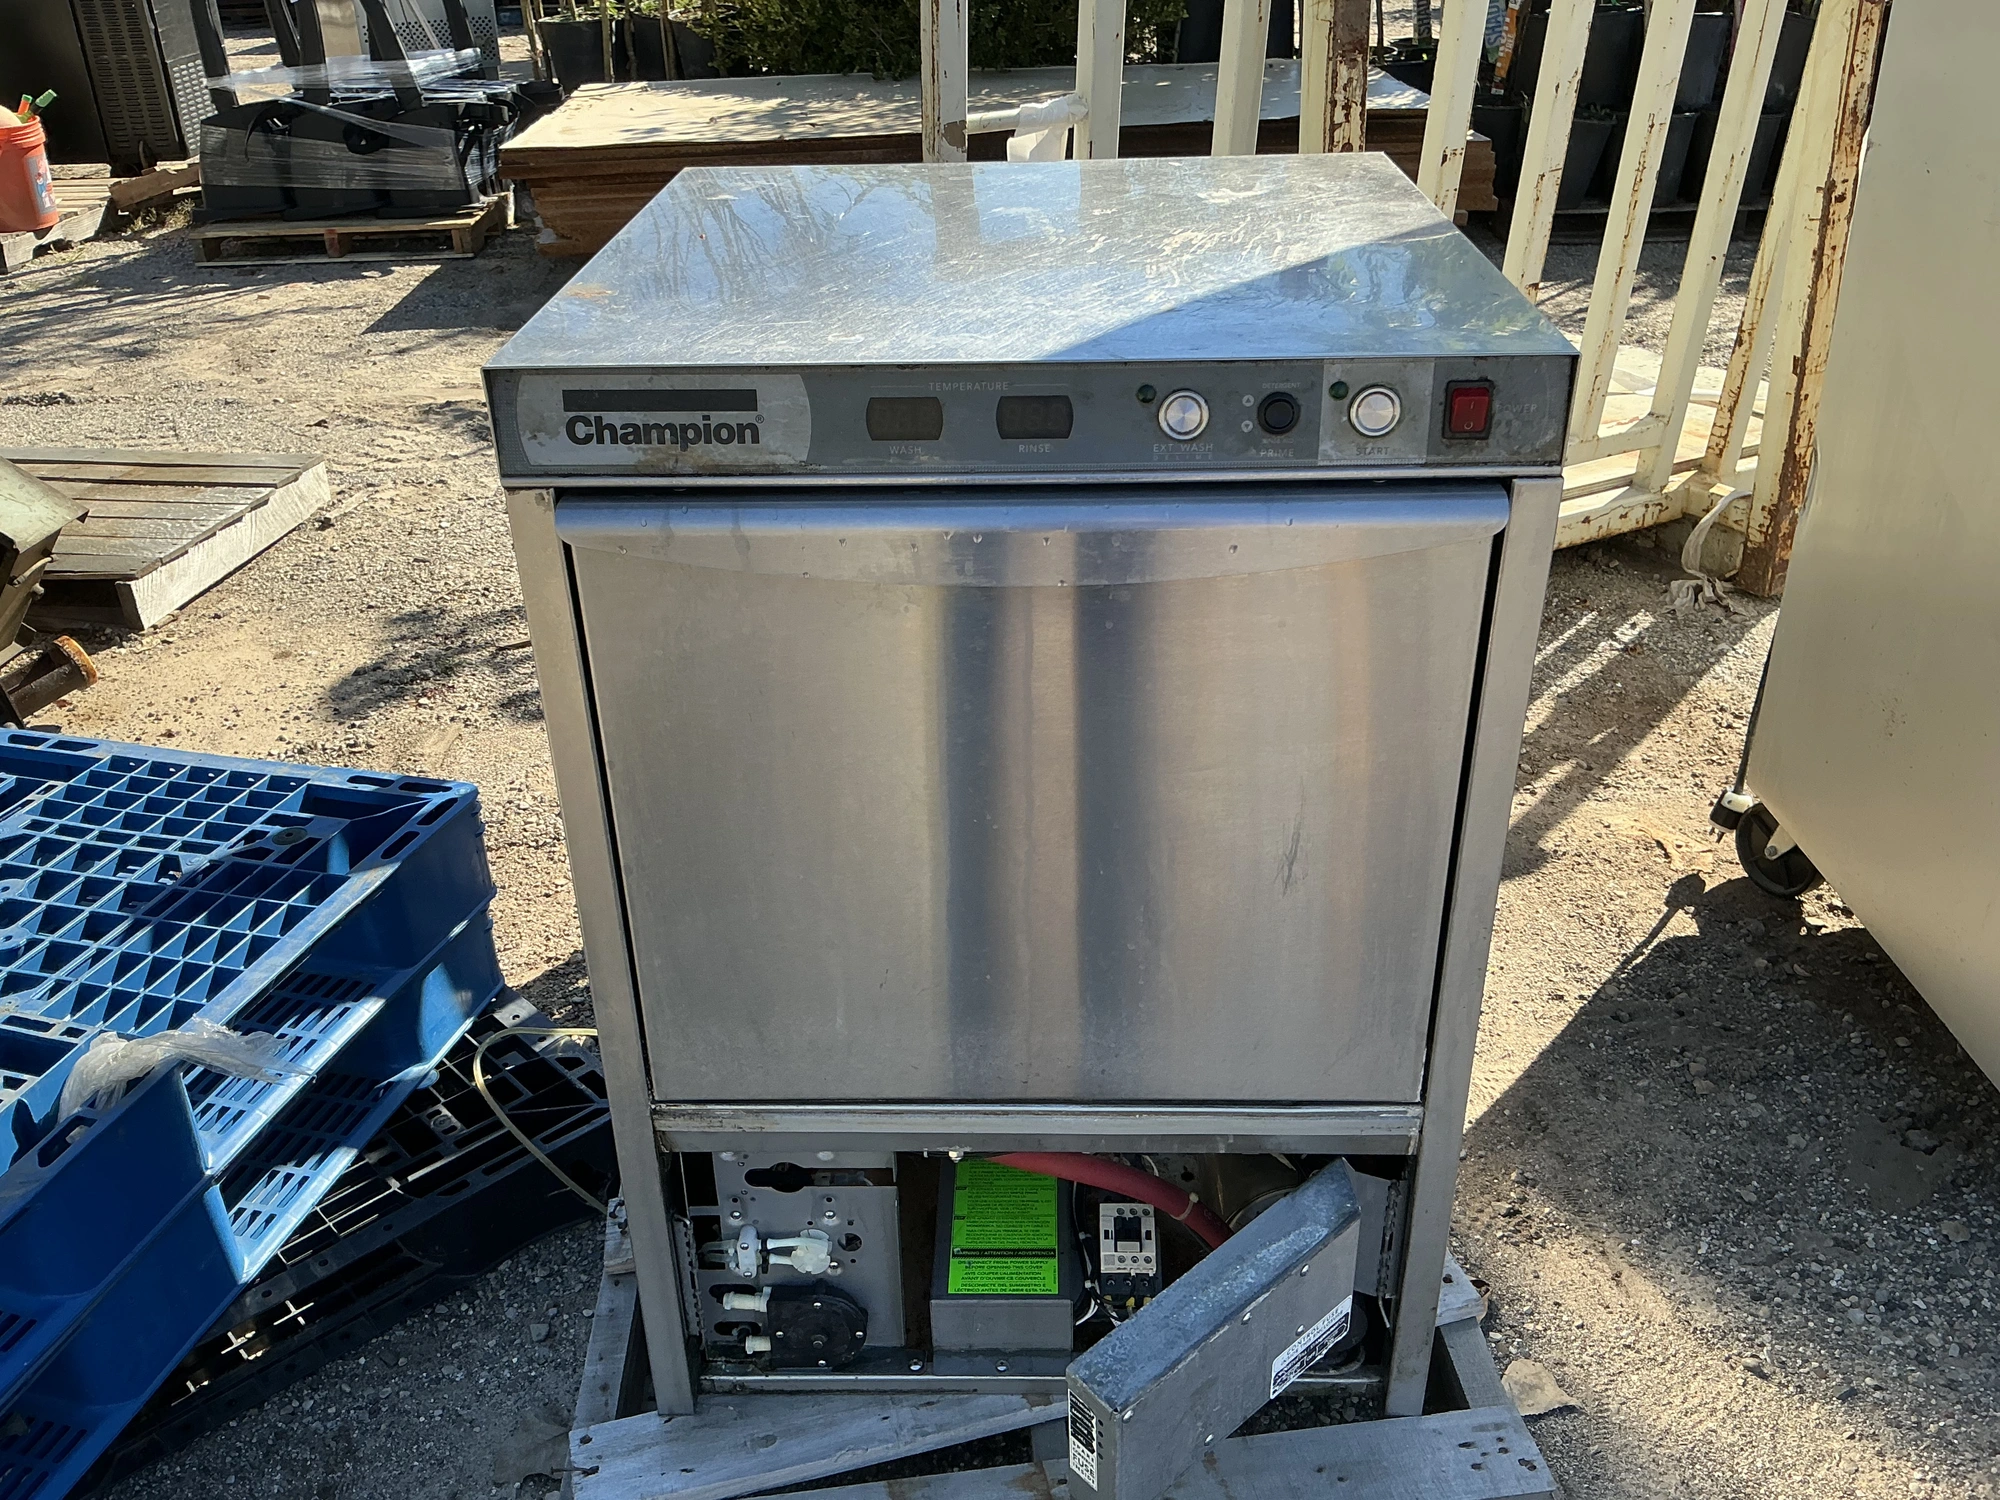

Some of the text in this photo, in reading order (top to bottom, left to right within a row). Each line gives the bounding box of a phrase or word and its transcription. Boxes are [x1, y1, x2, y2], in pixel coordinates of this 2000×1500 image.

[928, 381, 1009, 391] TEMPERATURE
[1496, 403, 1538, 413] POWER
[565, 414, 760, 452] Champion
[889, 445, 922, 455] WASH
[1018, 444, 1050, 454] RINSE
[1153, 443, 1214, 453] EXT WASH
[1260, 448, 1295, 458] PRIME
[1355, 446, 1389, 456] START
[1286, 1325, 1320, 1356] CONTROL
[1072, 1453, 1095, 1479] FUSE
